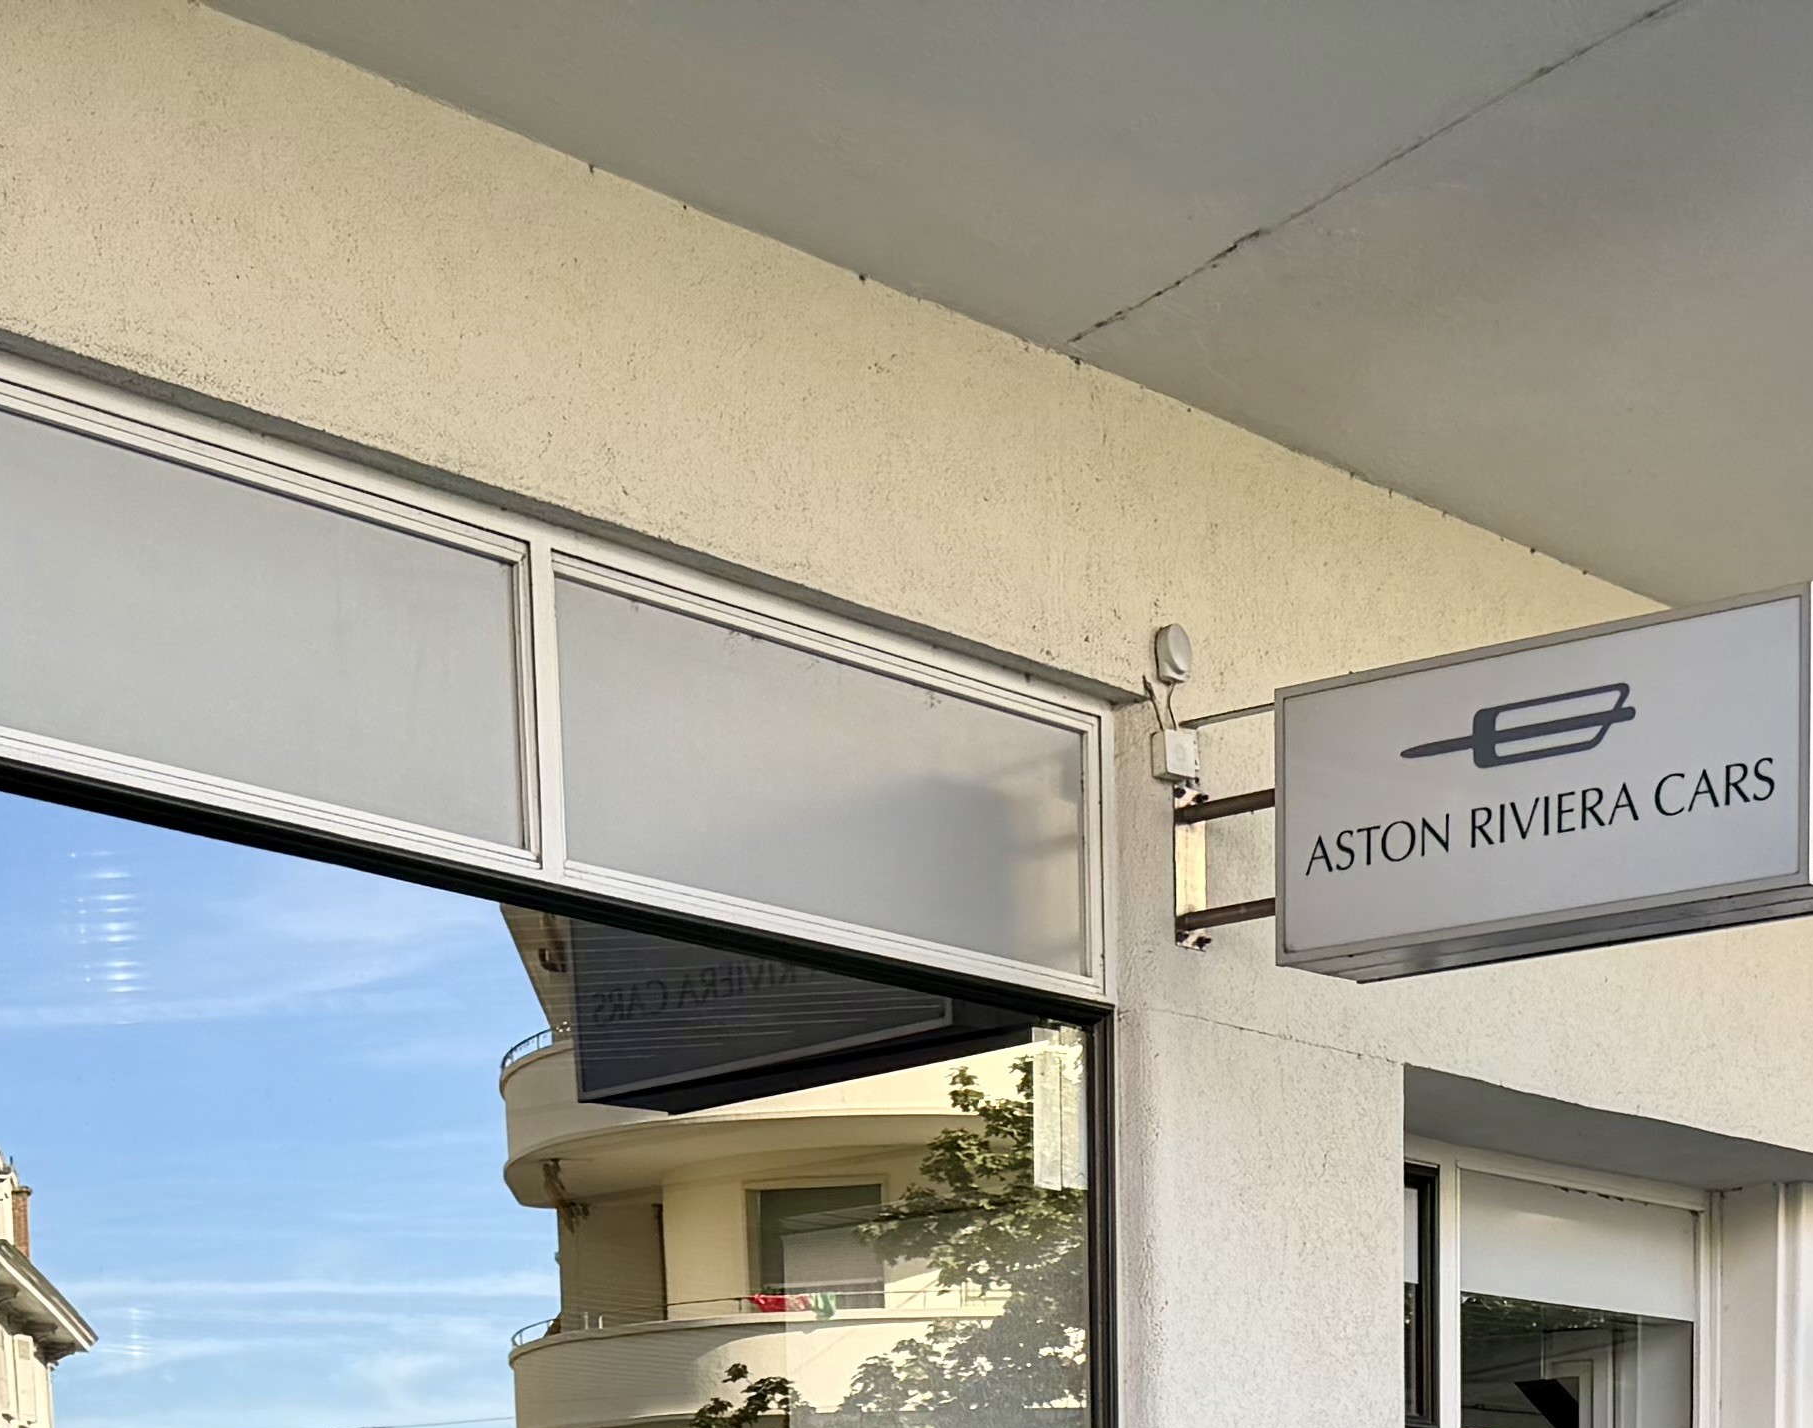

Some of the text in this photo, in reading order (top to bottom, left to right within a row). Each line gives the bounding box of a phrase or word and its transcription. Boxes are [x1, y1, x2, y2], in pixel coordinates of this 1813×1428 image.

[1305, 756, 1776, 877] ASTON RIVIERA CARS
